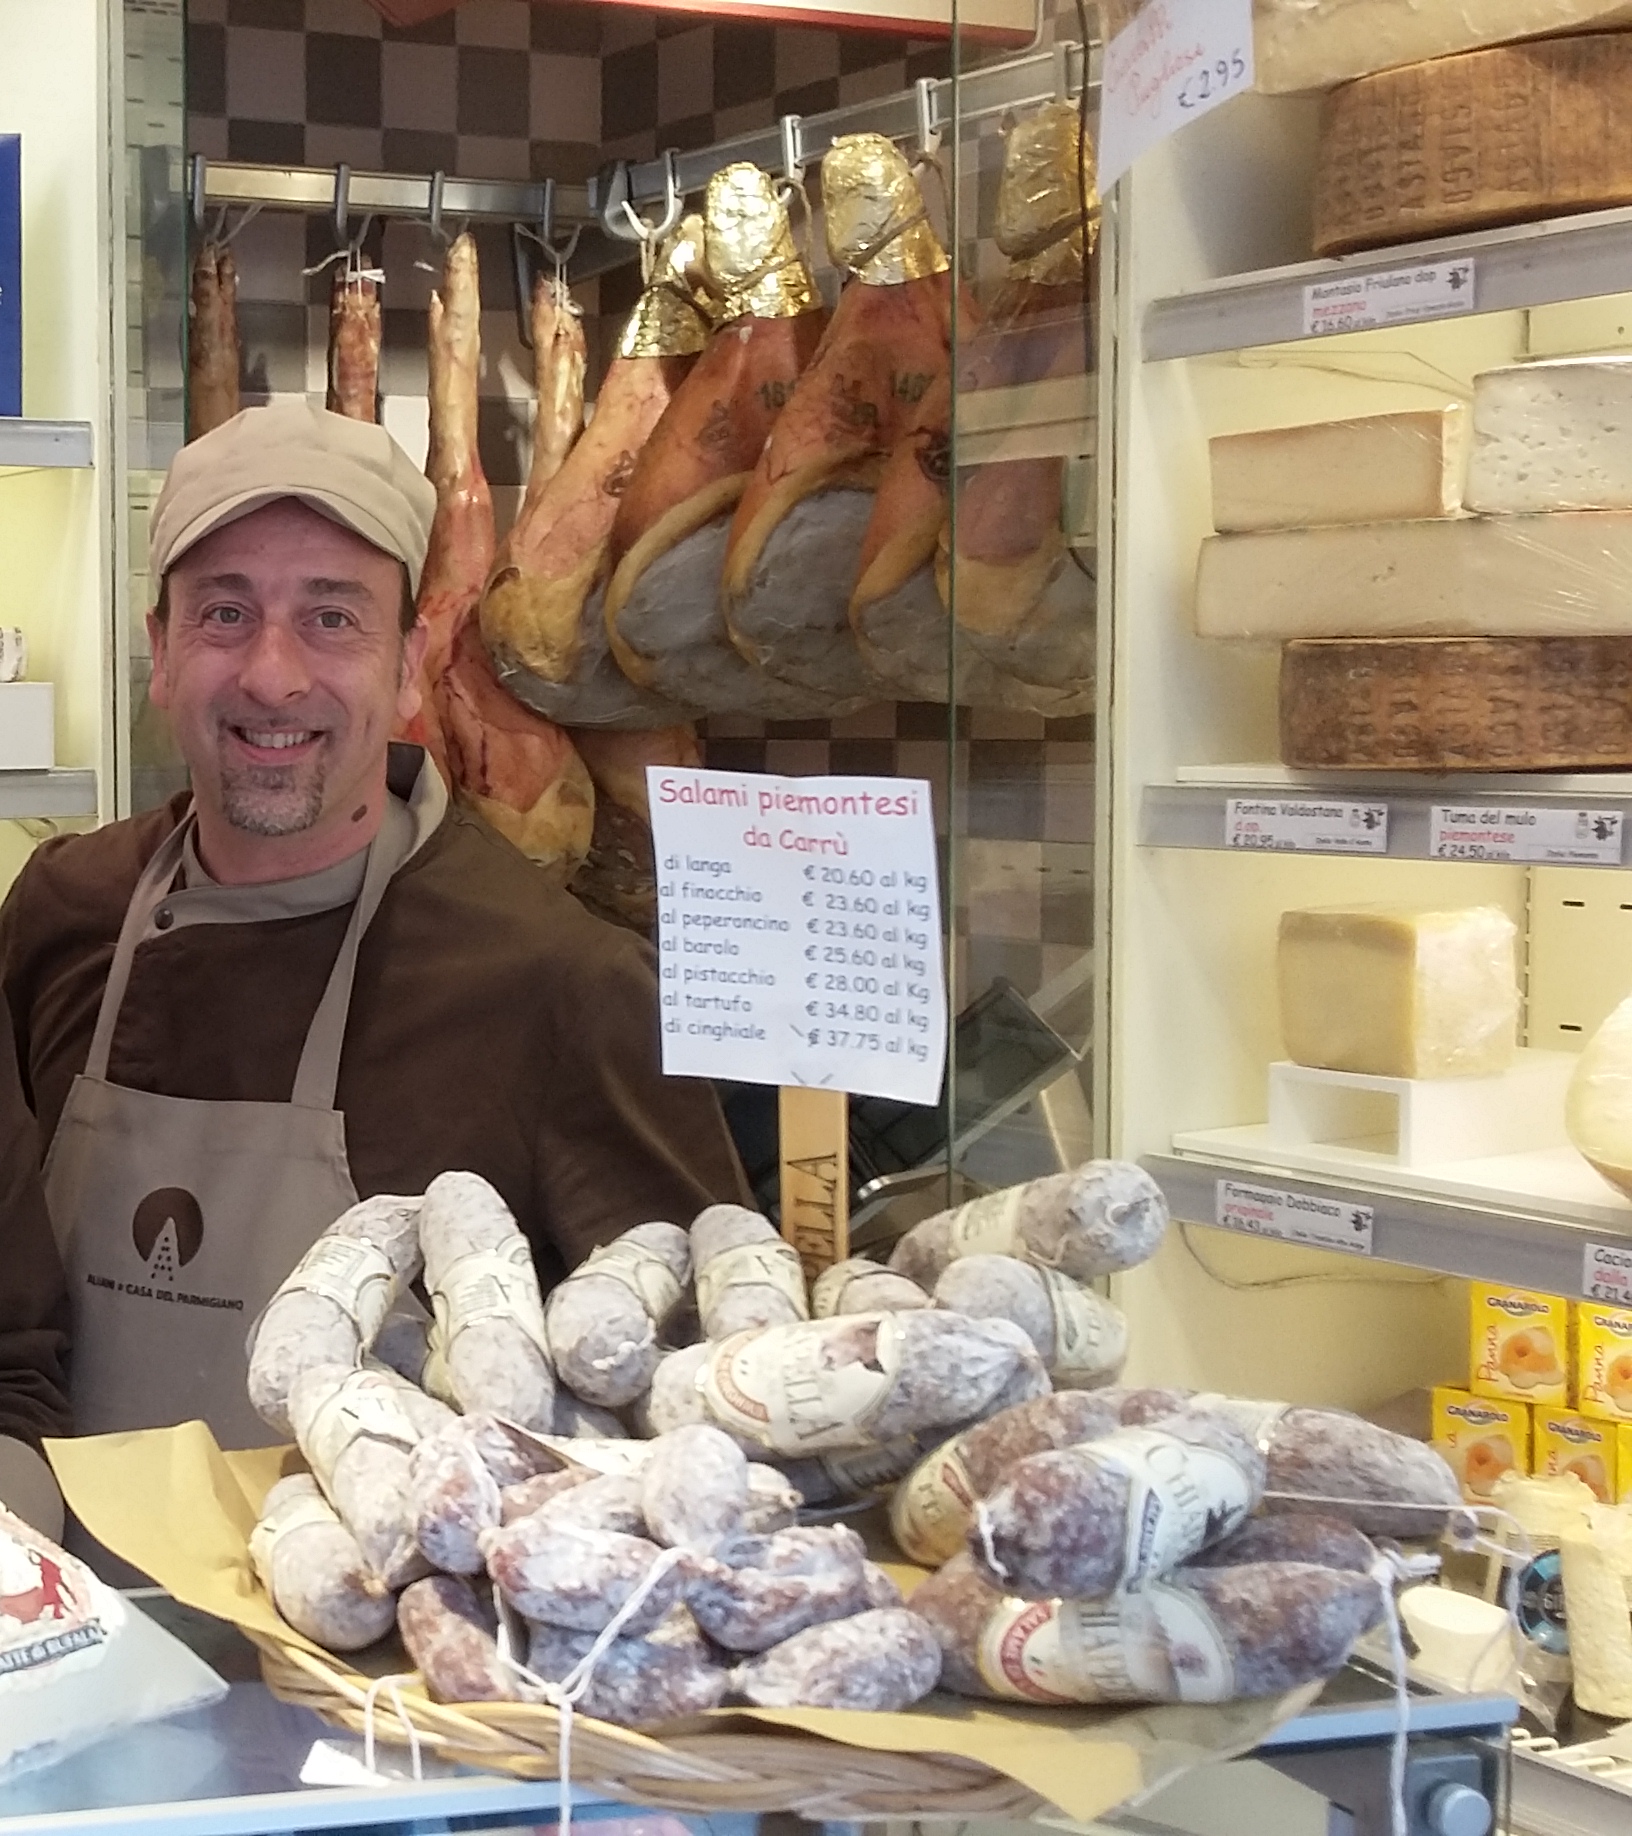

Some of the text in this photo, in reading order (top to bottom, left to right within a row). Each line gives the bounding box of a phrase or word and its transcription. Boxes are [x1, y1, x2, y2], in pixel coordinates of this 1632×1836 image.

[658, 778, 918, 817] Salami piemontesi
[1442, 809, 1476, 824] Tuma
[1480, 810, 1501, 825] del
[742, 825, 848, 857] da Carrù
[664, 855, 680, 870] di
[686, 855, 732, 877] langa
[820, 867, 875, 887] 20.60
[879, 871, 898, 888] al
[903, 871, 927, 893] kg
[660, 880, 674, 897] al
[682, 882, 763, 902] finocchio
[824, 894, 879, 914] 23.60
[882, 900, 899, 916] al
[906, 900, 931, 922] kg
[661, 908, 676, 924] al
[682, 913, 790, 932] peperoncino
[824, 920, 878, 941] 23.60
[882, 926, 899, 942] al
[904, 927, 928, 950] kg
[661, 935, 677, 951] al
[683, 937, 740, 955] barolo
[822, 946, 877, 966] 25.60
[881, 952, 898, 969] al
[903, 954, 926, 977] kg
[662, 963, 677, 979] al
[683, 965, 776, 985] pistacchio
[824, 973, 879, 995] 28.00
[882, 980, 899, 996] al
[906, 982, 930, 1005] Kg
[662, 990, 678, 1006] al
[685, 993, 752, 1012] tartufo
[824, 1002, 879, 1023] 34.80
[884, 1008, 901, 1025] al
[907, 1009, 930, 1033] kg
[664, 1018, 681, 1034] di
[687, 1020, 766, 1042] cinghiale
[826, 1030, 880, 1052] 37.75
[885, 1037, 901, 1053] al
[907, 1038, 929, 1062] kg
[87, 1273, 244, 1311] ALIANI CASA DEL PARMIGIANO
[1486, 1296, 1550, 1313] GRANAROLO
[1477, 1324, 1500, 1382] Panna
[1584, 1344, 1606, 1404] Panna
[1447, 1405, 1509, 1422] GRANAROLO
[1547, 1421, 1602, 1442] GRANAROLO
